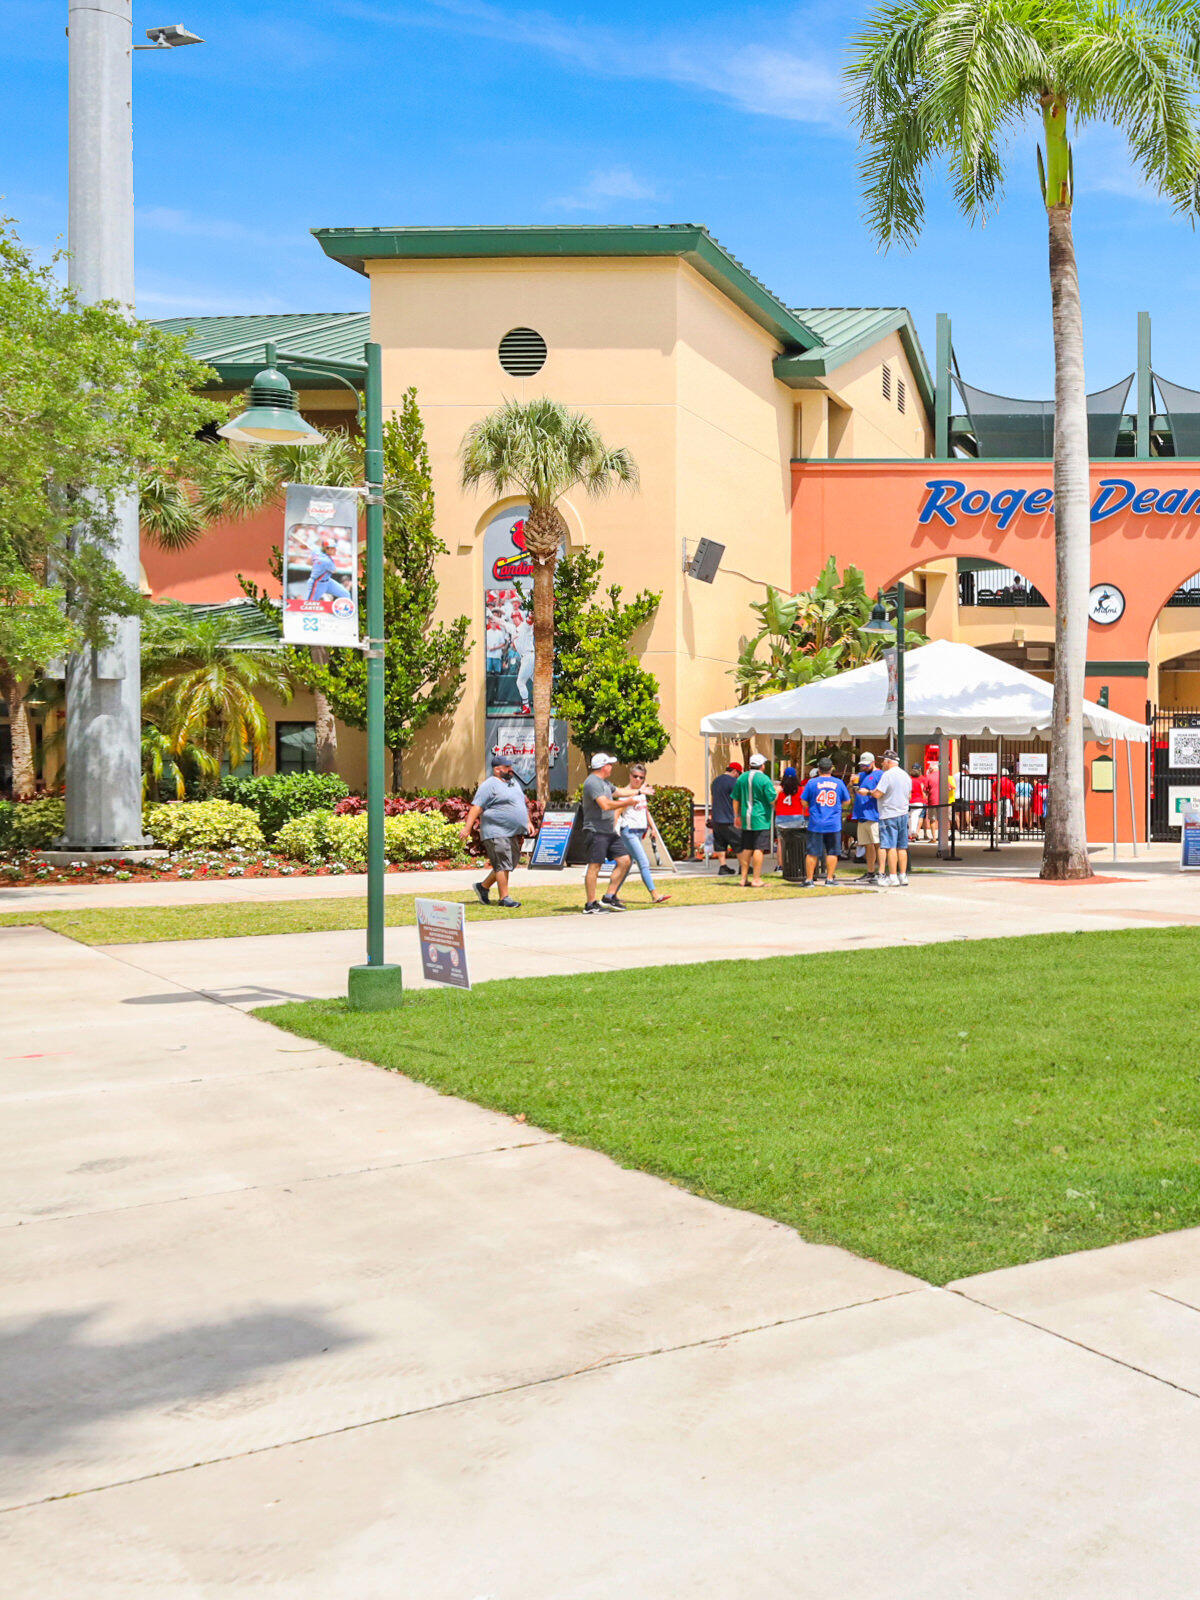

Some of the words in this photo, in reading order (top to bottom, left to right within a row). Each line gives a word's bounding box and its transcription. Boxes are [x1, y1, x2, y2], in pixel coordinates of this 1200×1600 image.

[918, 479, 1055, 530] Roge
[492, 557, 535, 581] Cardin
[783, 795, 791, 806] 4
[816, 790, 837, 807] 48
